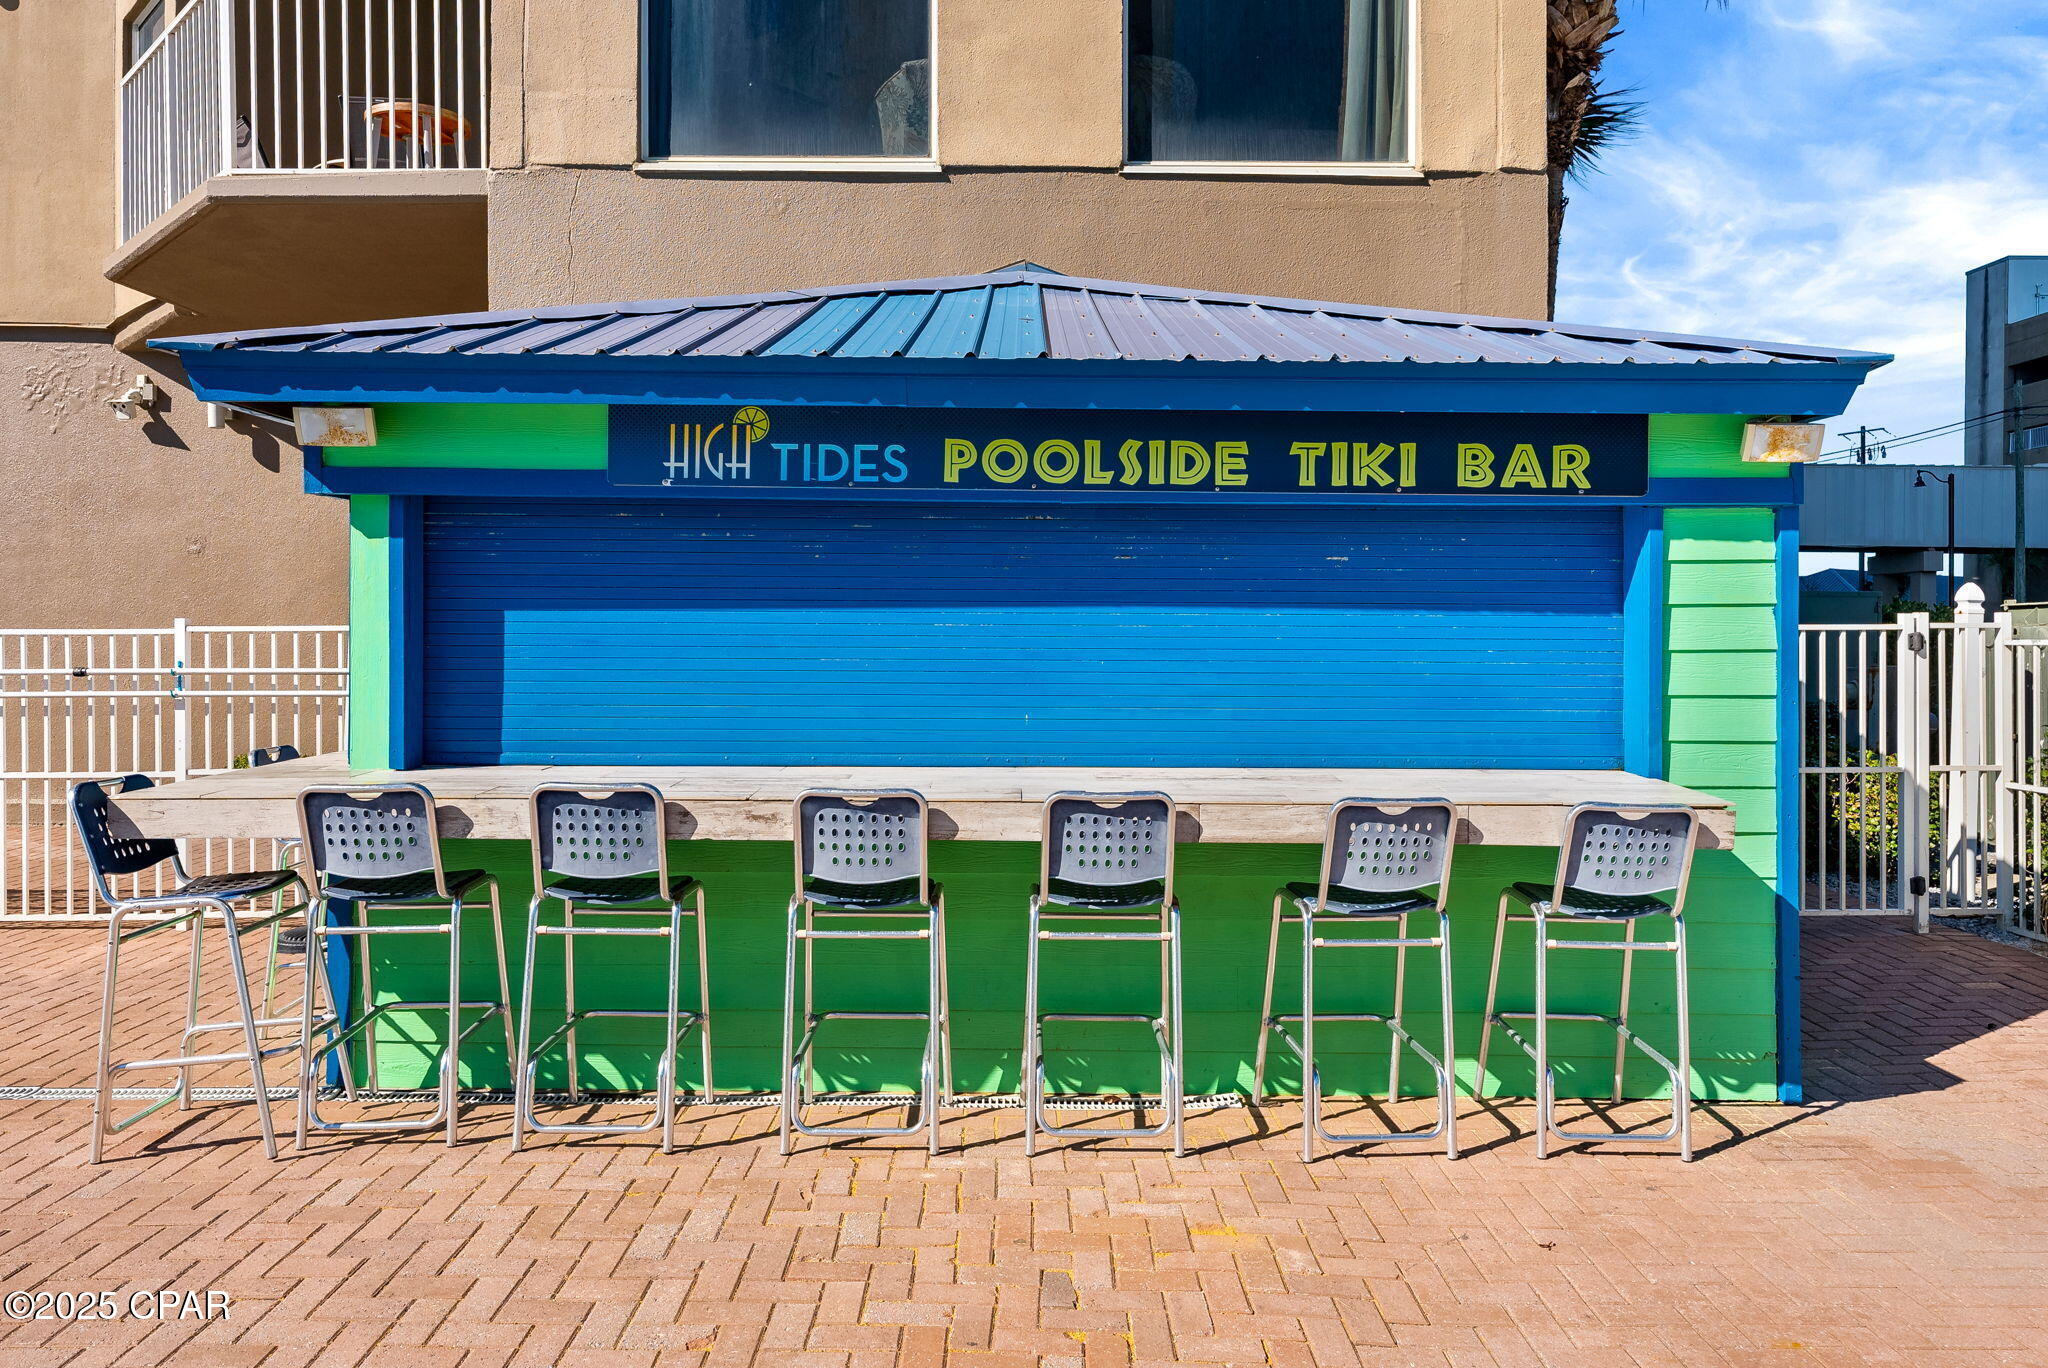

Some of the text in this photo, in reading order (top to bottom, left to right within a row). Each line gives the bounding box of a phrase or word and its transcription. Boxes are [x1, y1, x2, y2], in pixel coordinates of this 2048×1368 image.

[662, 423, 1592, 490] HIGH TIDES POOLSIDE TIKI BAR
